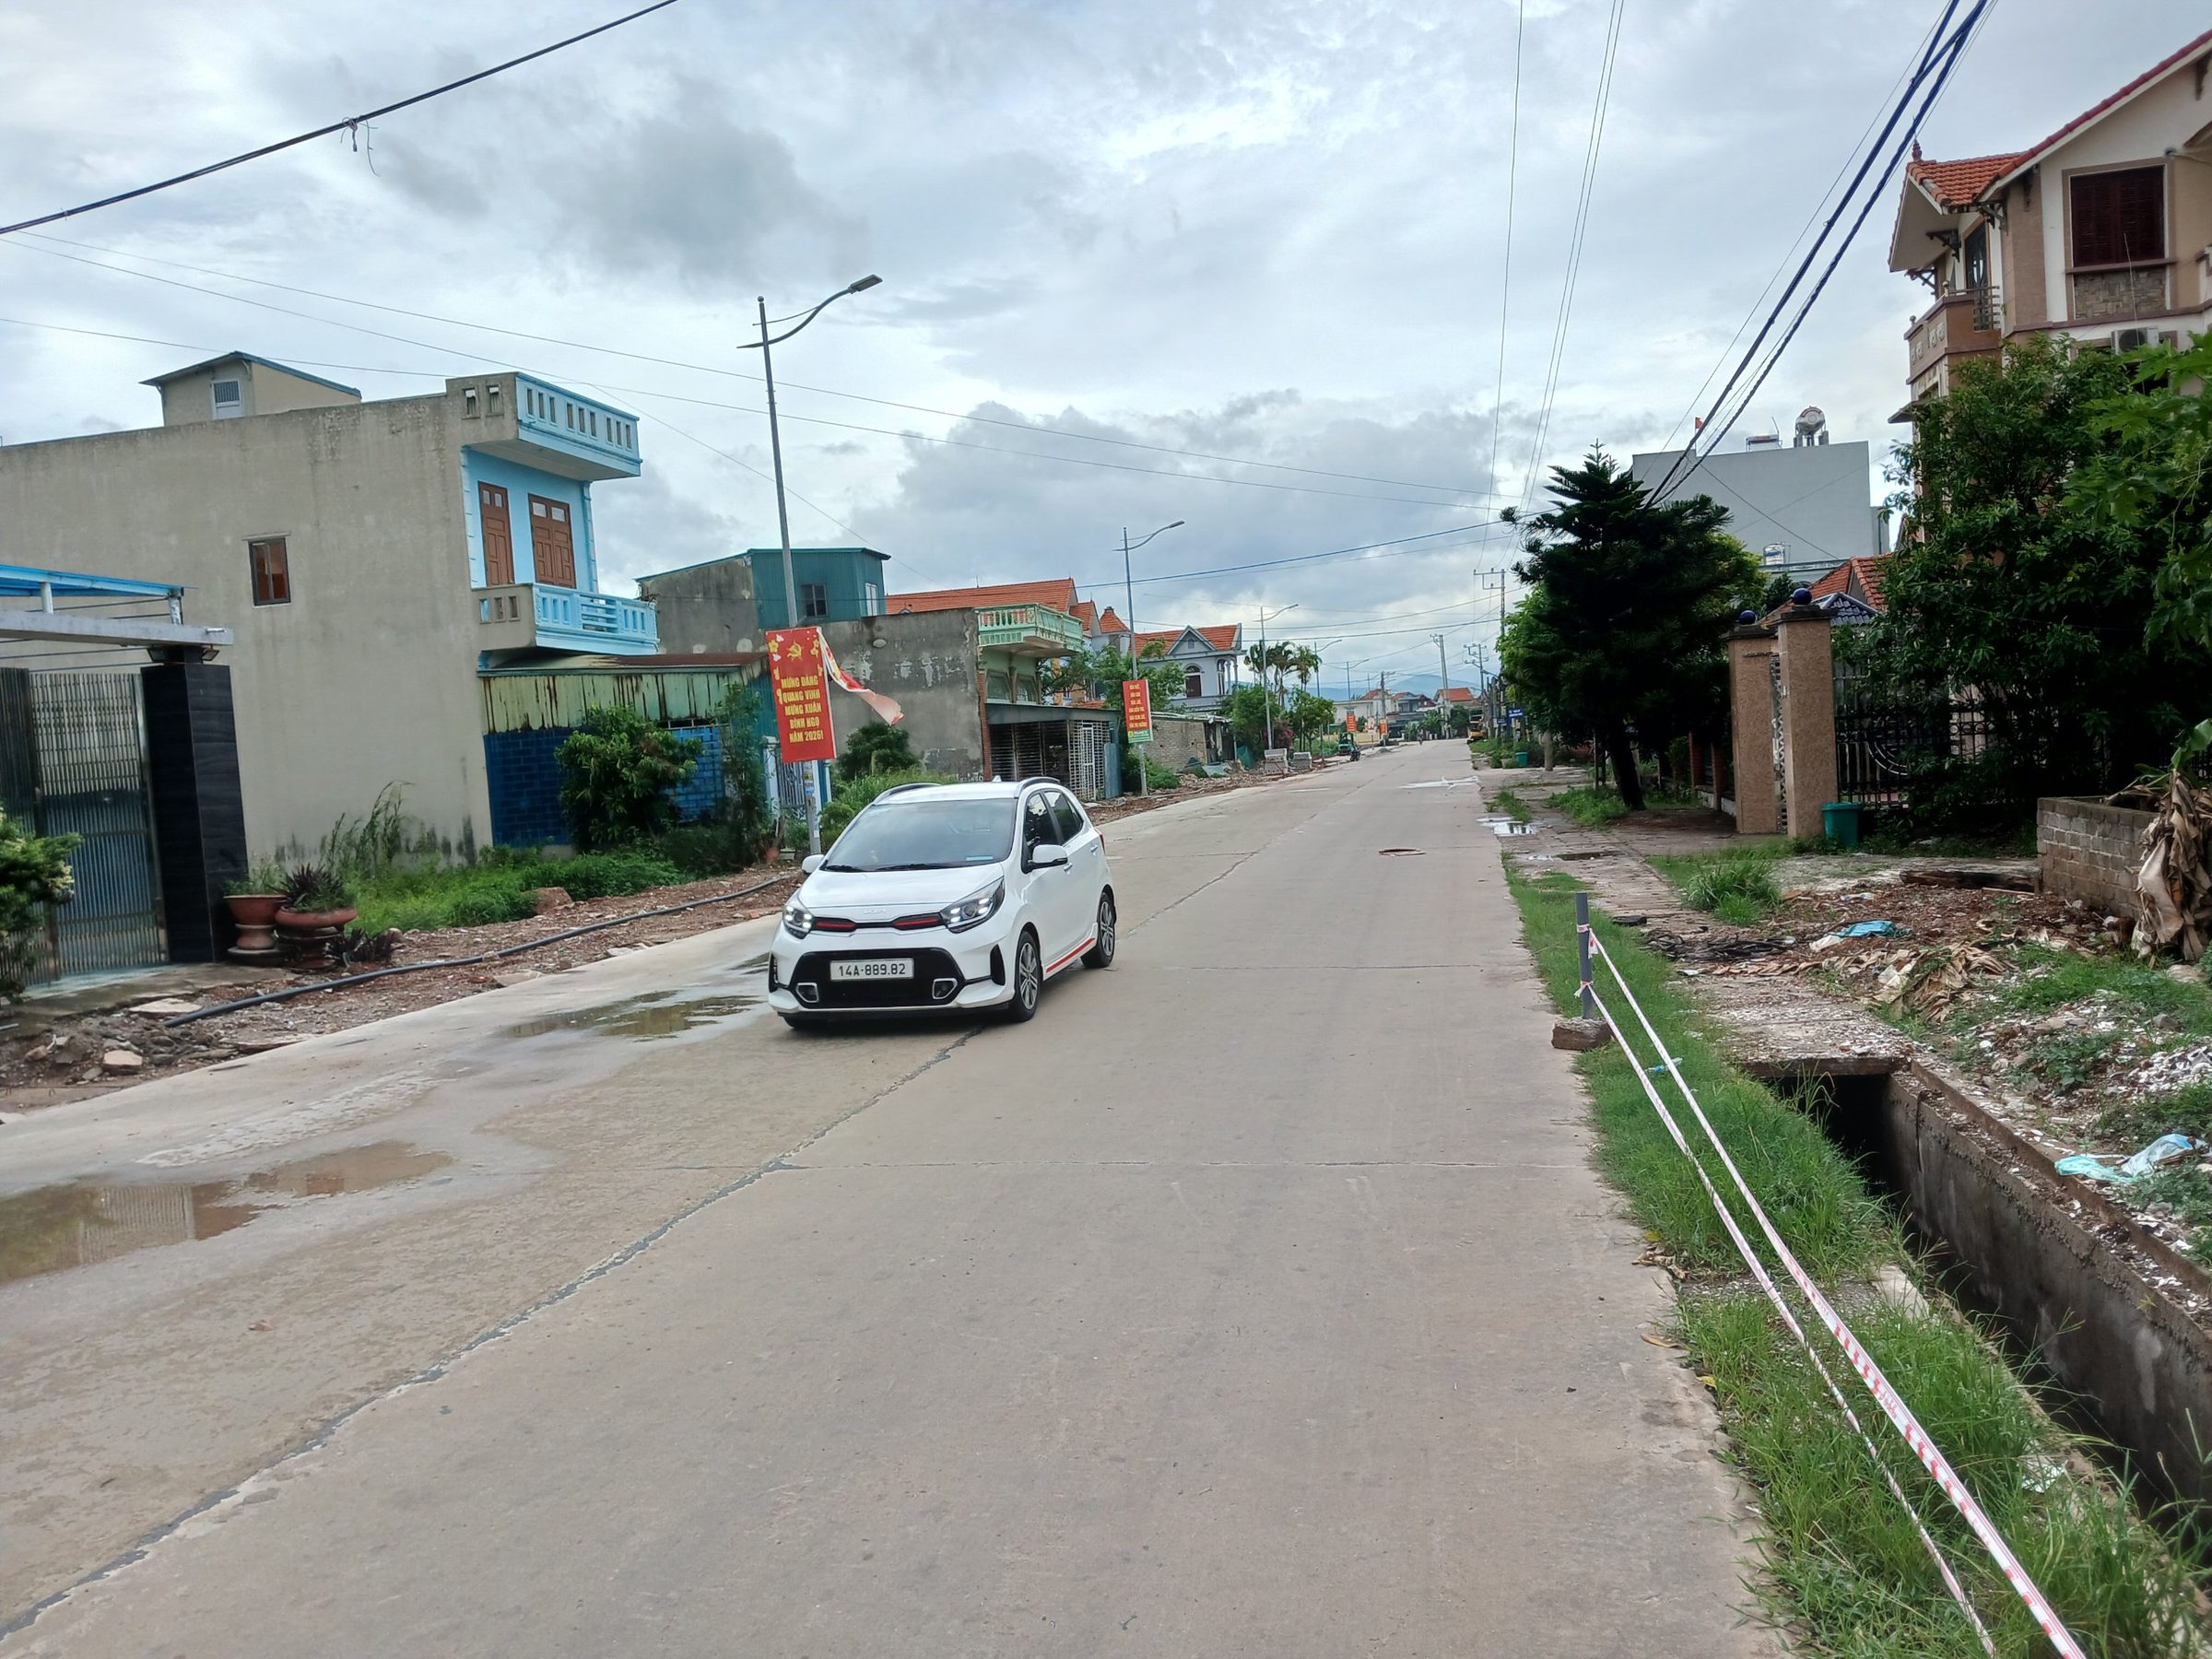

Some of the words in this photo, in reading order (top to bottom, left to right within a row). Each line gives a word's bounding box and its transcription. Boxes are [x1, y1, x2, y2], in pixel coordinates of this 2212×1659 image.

[782, 690, 804, 703] QUANG
[804, 688, 820, 700] VINH
[805, 729, 824, 741] 2026!
